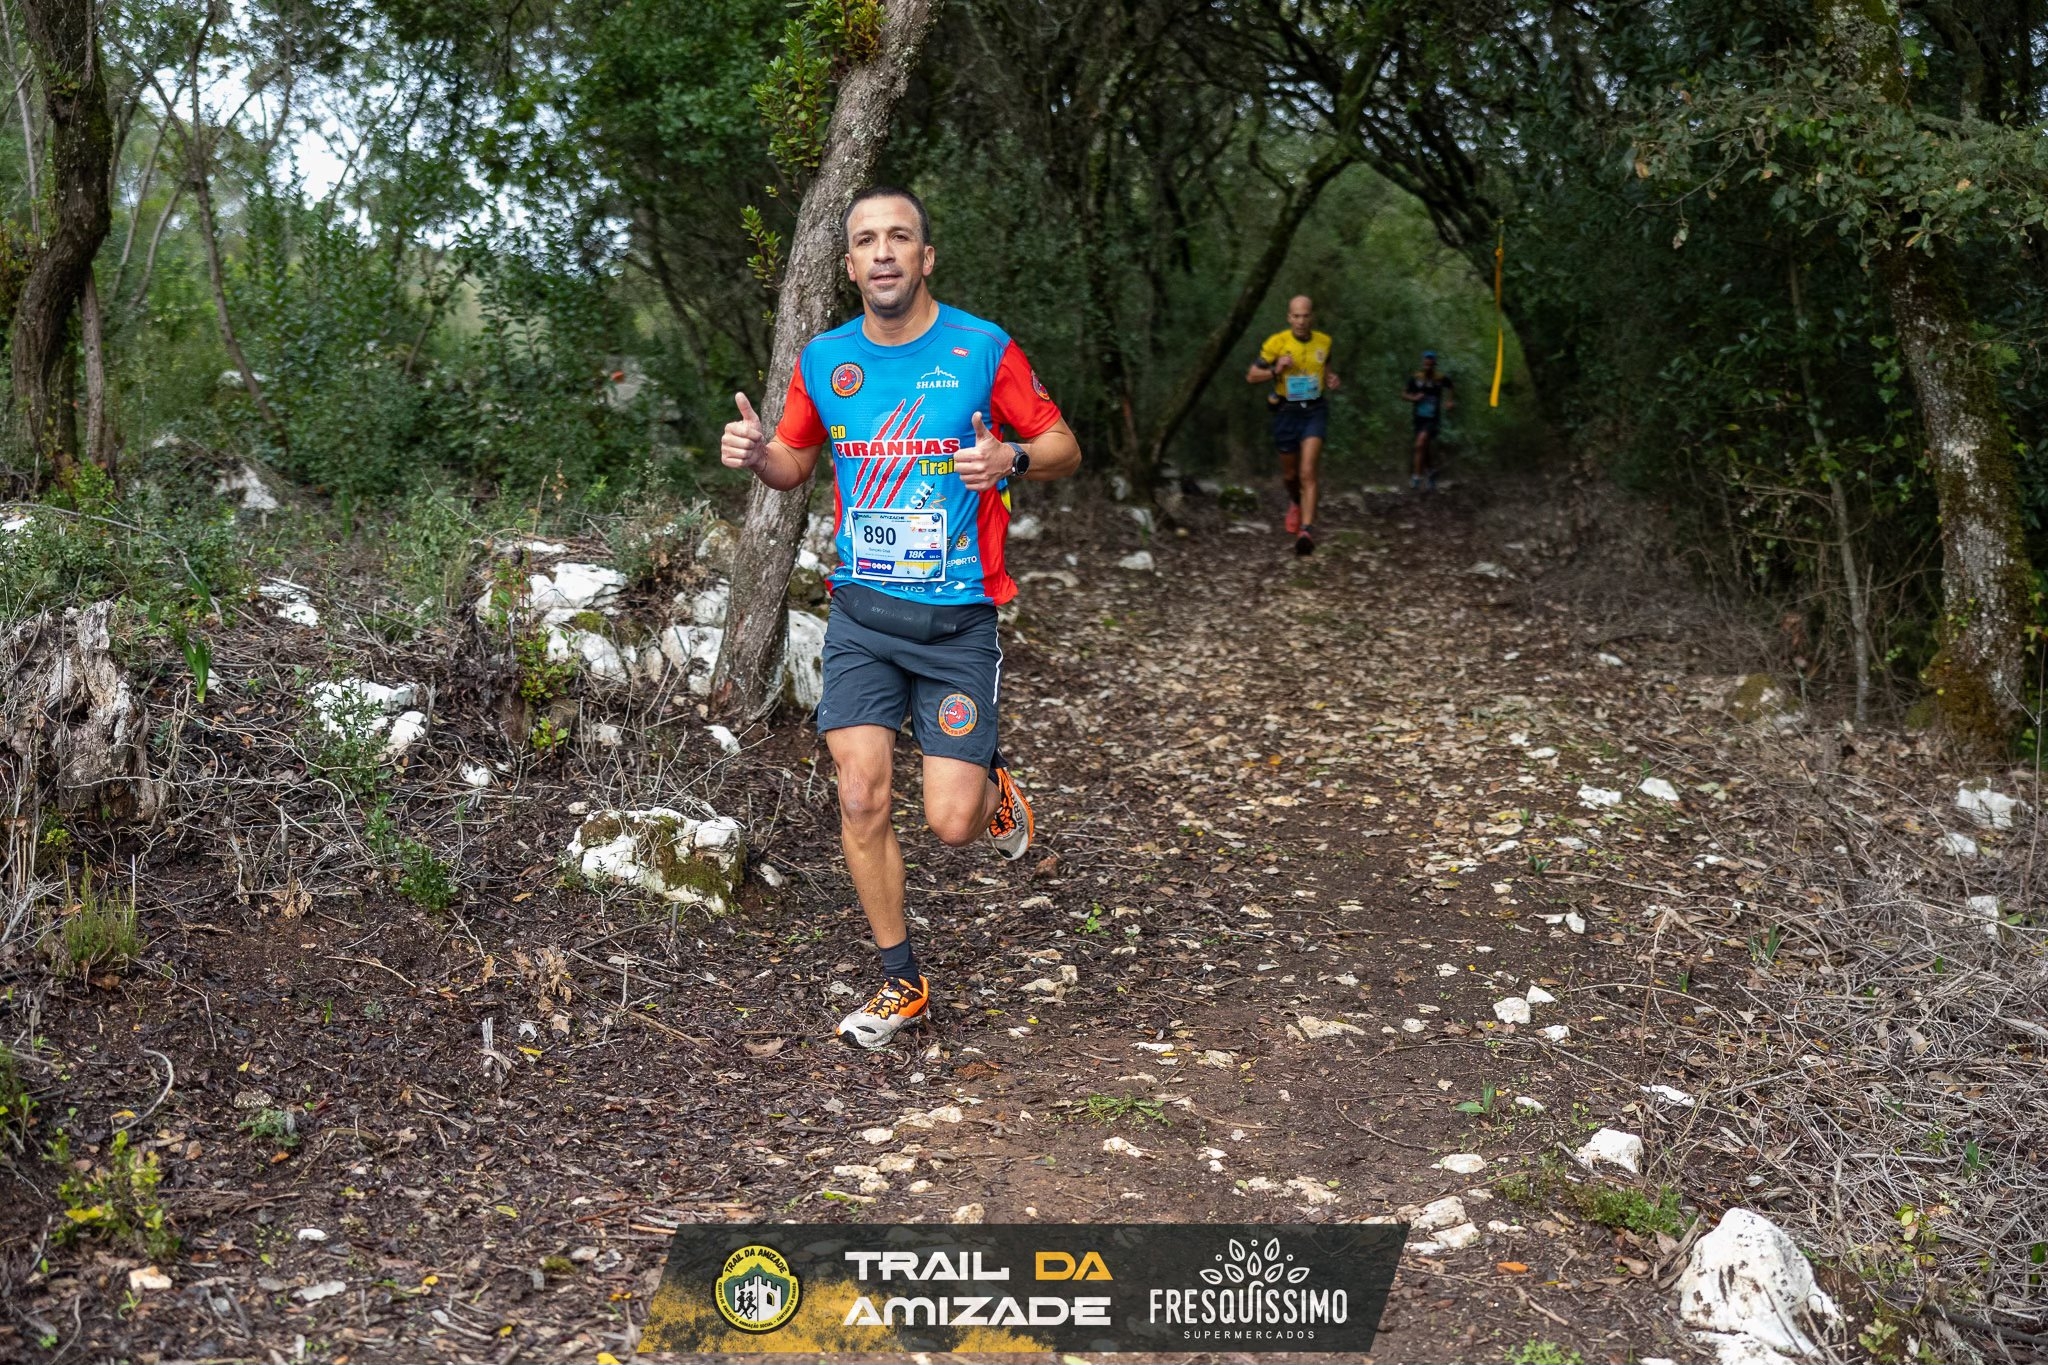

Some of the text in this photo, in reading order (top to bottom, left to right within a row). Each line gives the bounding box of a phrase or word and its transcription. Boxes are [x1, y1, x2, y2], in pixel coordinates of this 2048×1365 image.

[915, 379, 960, 390] SHARISH
[830, 425, 847, 440] GD
[834, 438, 960, 457] PIRANHAS
[919, 459, 954, 477] Trai
[864, 524, 897, 546] 890
[908, 551, 928, 559] 18K
